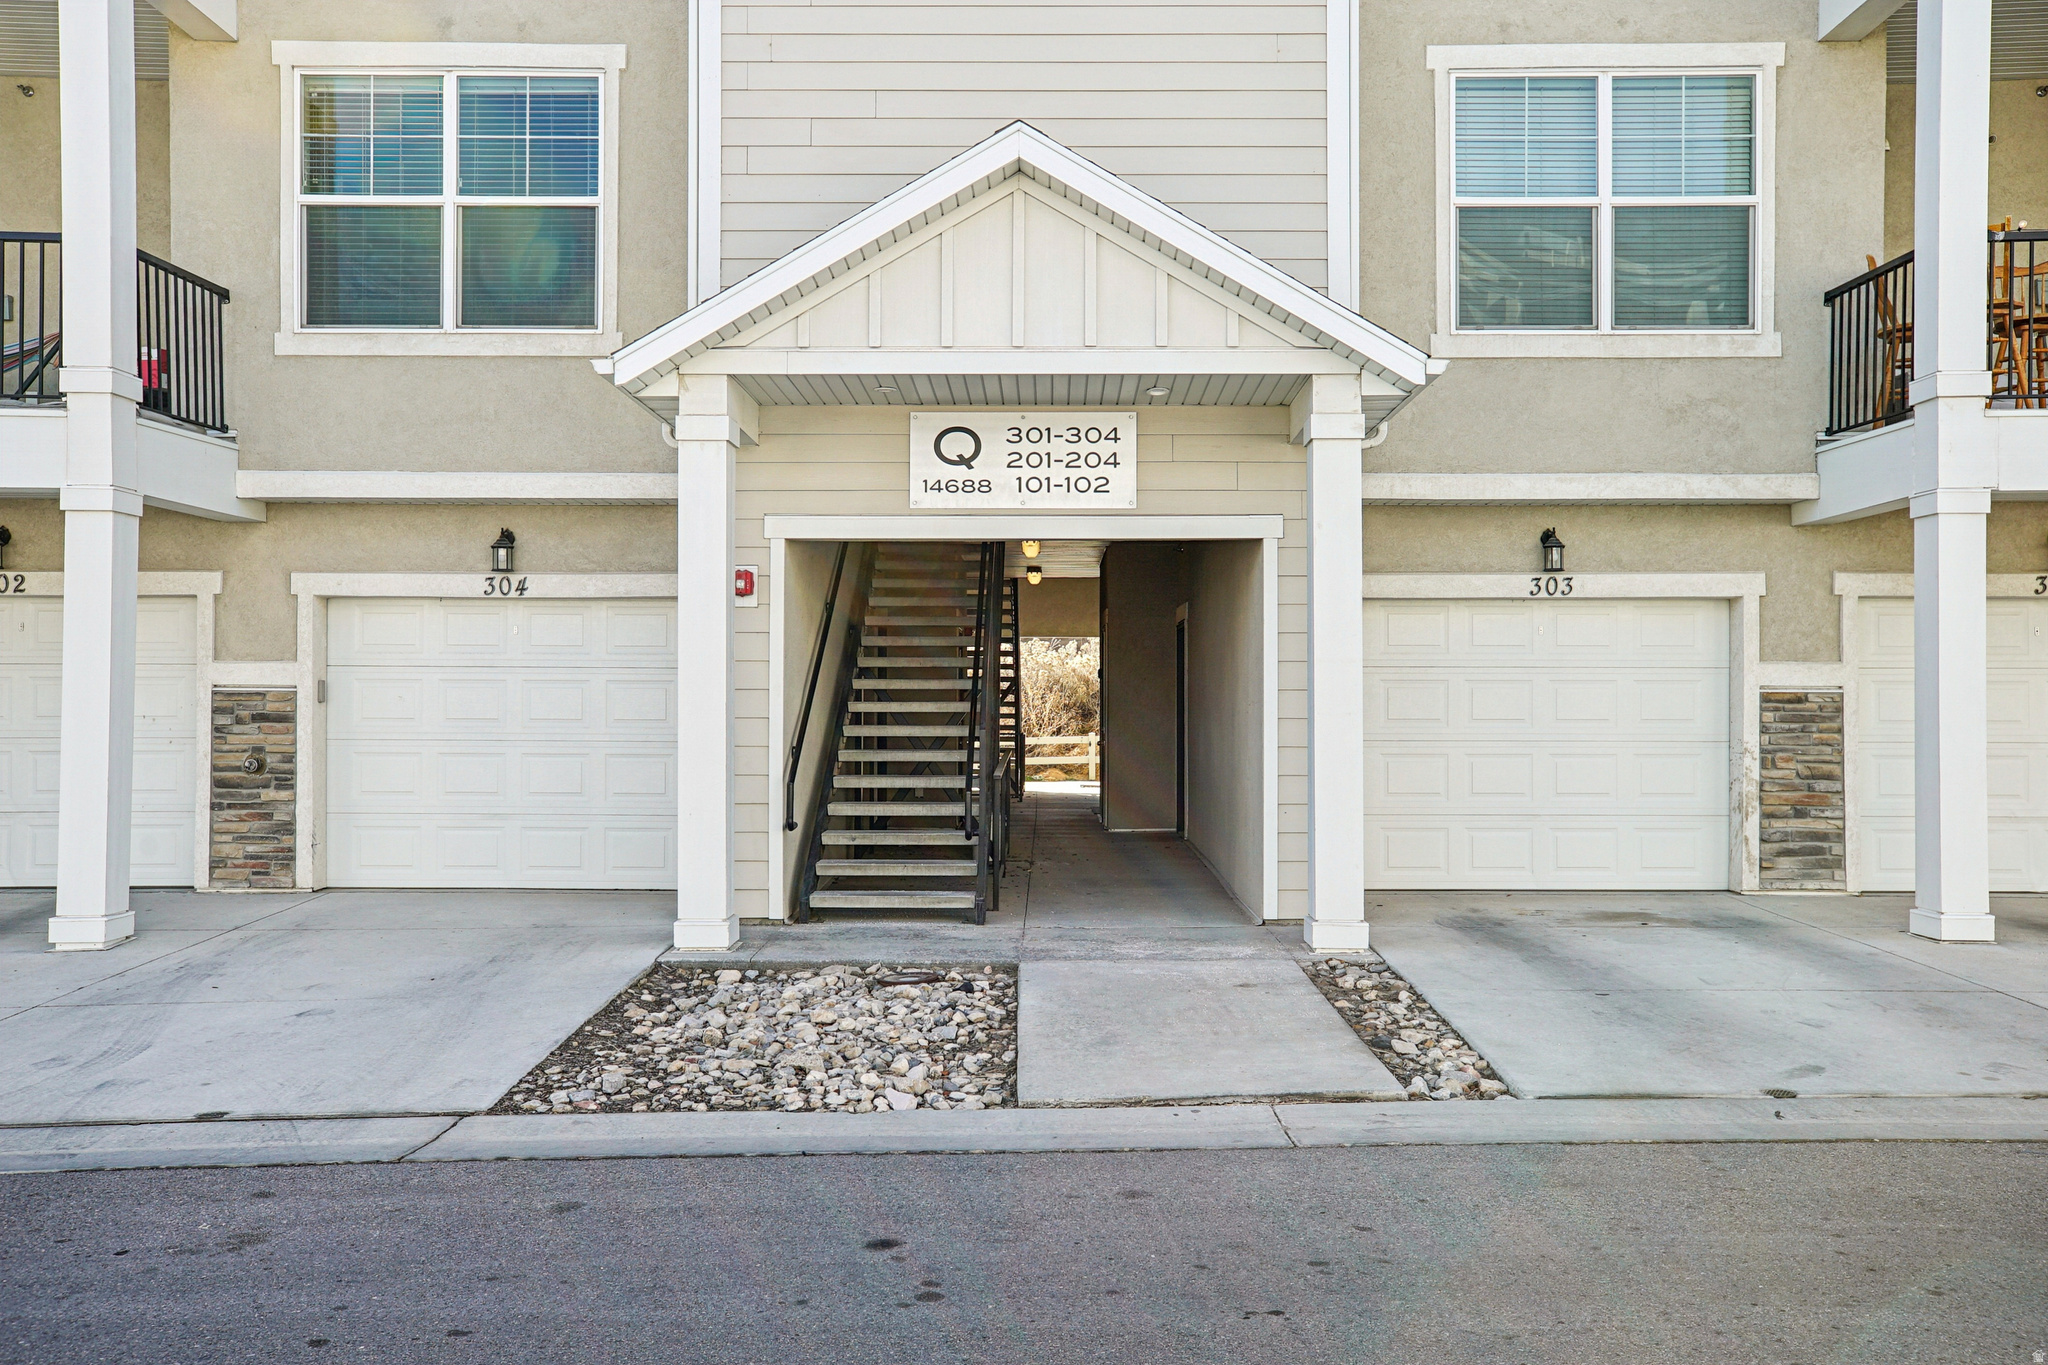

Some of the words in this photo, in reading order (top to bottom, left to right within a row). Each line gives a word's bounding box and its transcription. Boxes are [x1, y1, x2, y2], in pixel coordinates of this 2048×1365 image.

[1006, 427, 1121, 444] 301-304
[934, 426, 982, 470] Q
[1006, 452, 1121, 469] 201-204
[922, 479, 992, 494] 14688
[1016, 476, 1110, 494] 101-102
[483, 576, 529, 597] 304
[1529, 576, 1574, 597] 303
[2034, 575, 2048, 596] 3
